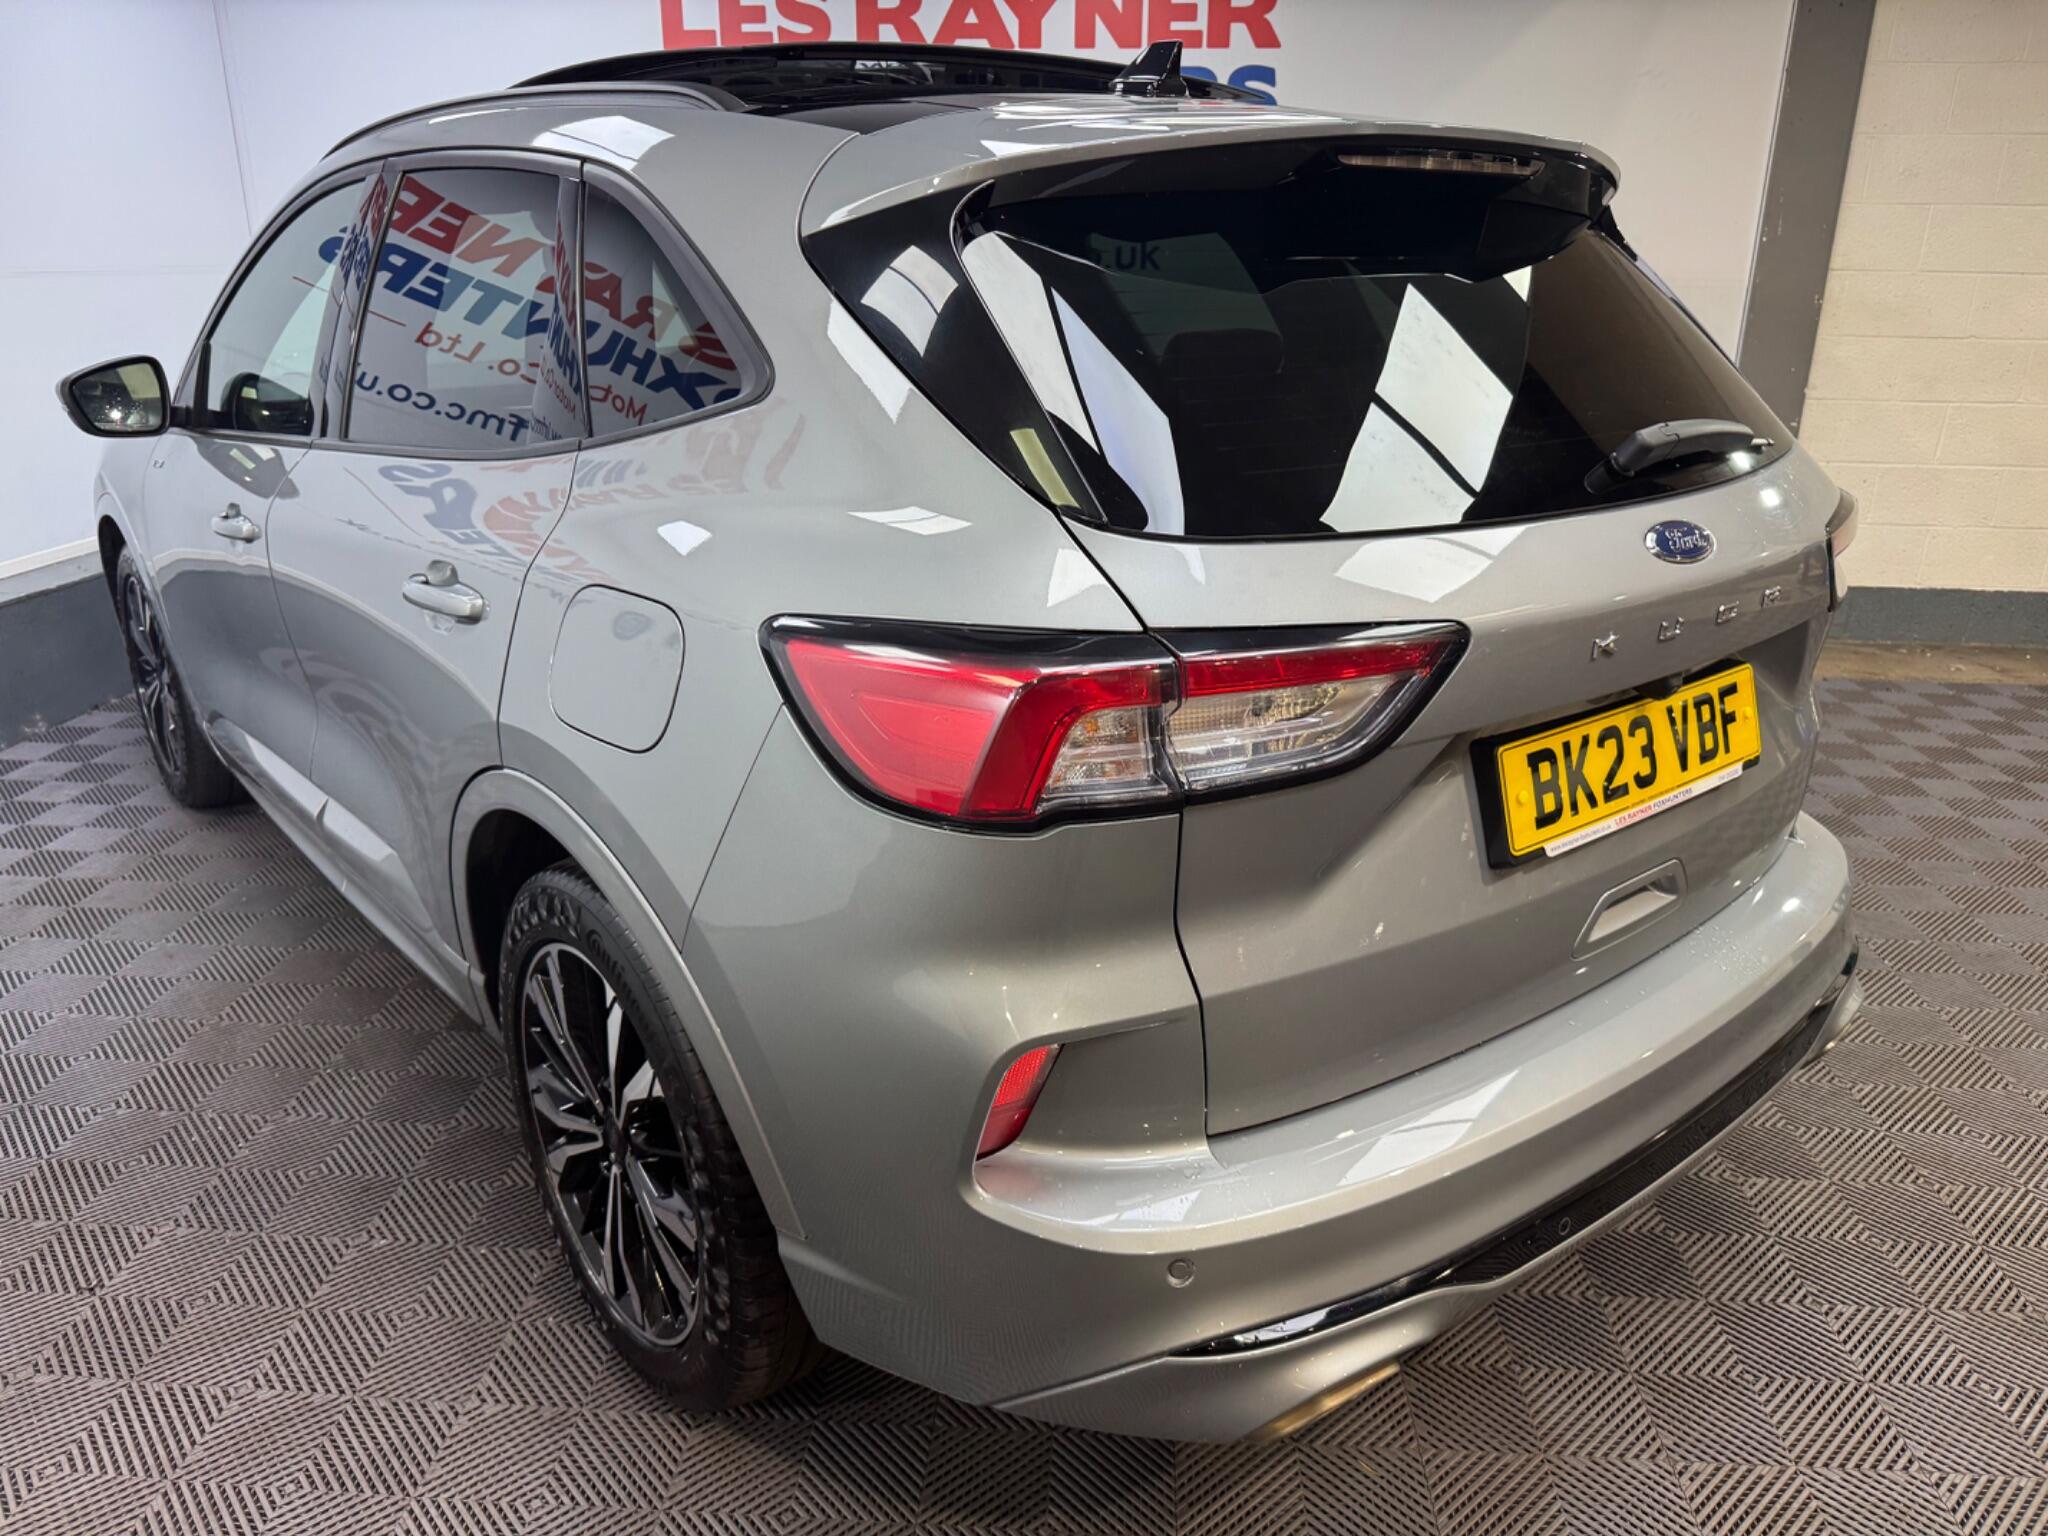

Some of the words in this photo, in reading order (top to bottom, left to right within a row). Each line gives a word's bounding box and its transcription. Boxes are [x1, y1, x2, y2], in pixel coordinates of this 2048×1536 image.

[661, 0, 831, 49] LES
[857, 0, 1281, 49] RAYNER
[1526, 714, 1658, 830] BK23
[1666, 683, 1739, 773] VBF
[1628, 804, 1653, 822] RAYNER
[1653, 787, 1694, 809] FOXHUNTERS
